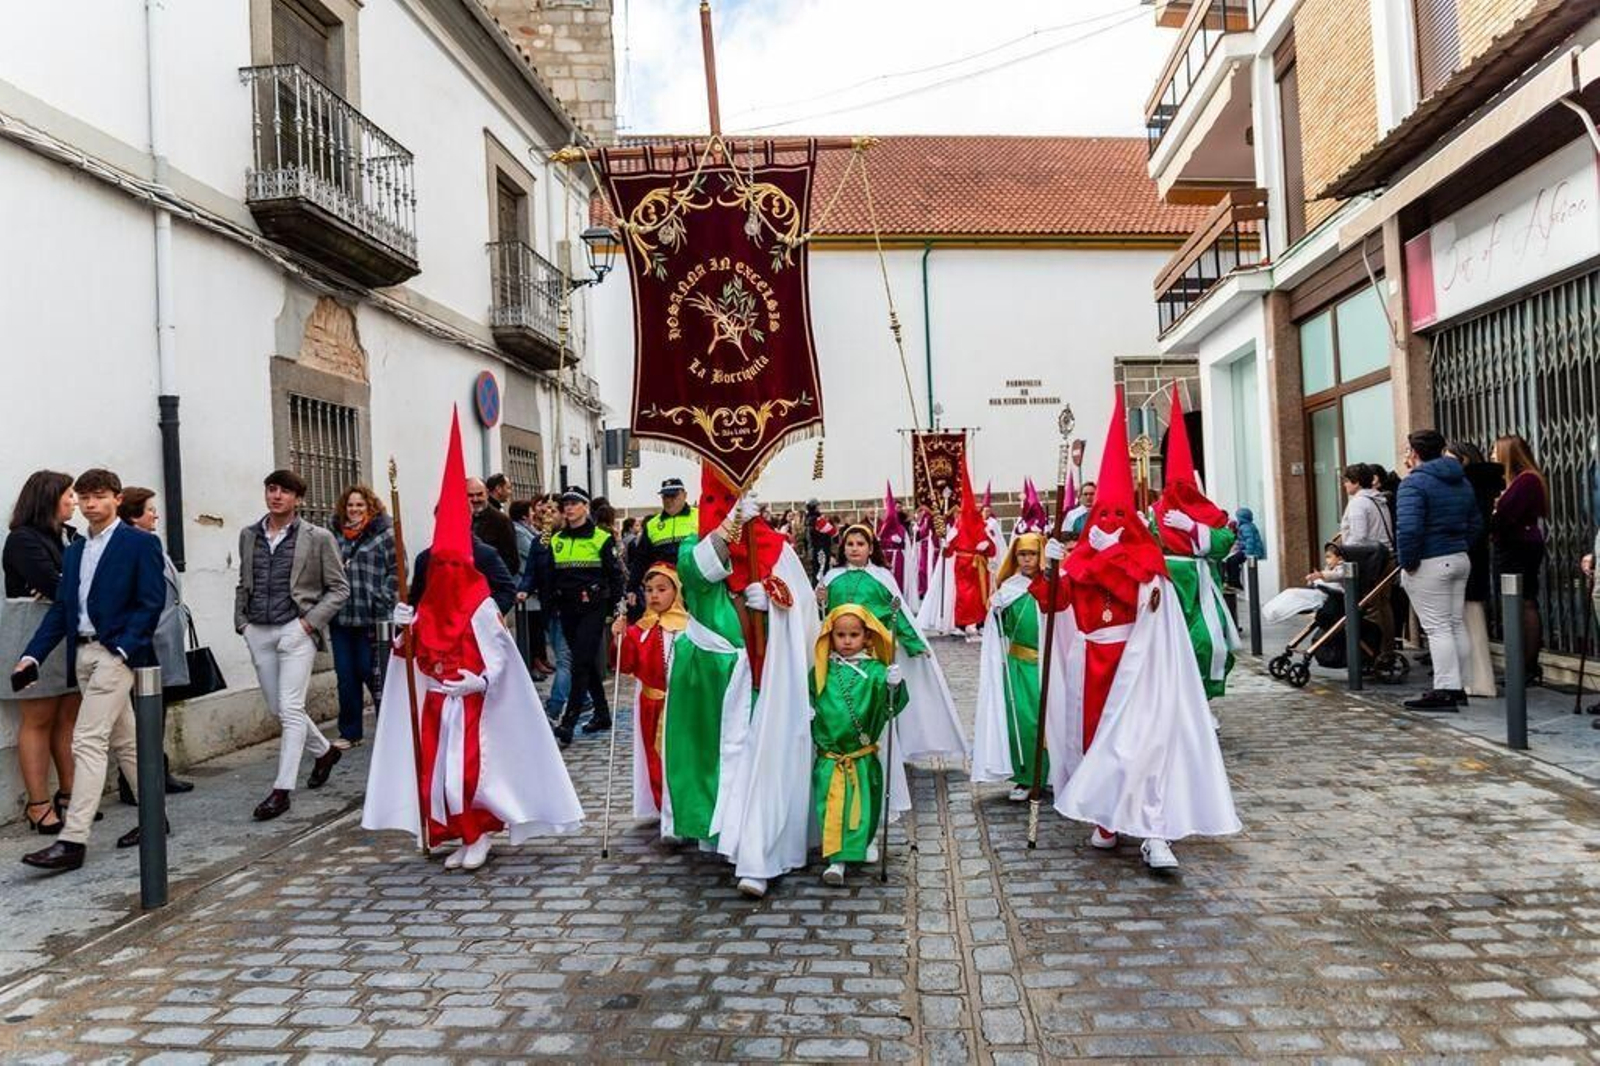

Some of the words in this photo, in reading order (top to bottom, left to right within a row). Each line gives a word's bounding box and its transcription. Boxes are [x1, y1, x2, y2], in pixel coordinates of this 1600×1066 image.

[709, 257, 731, 271] IN
[688, 357, 706, 379] La
[711, 355, 769, 385] Borriquita
